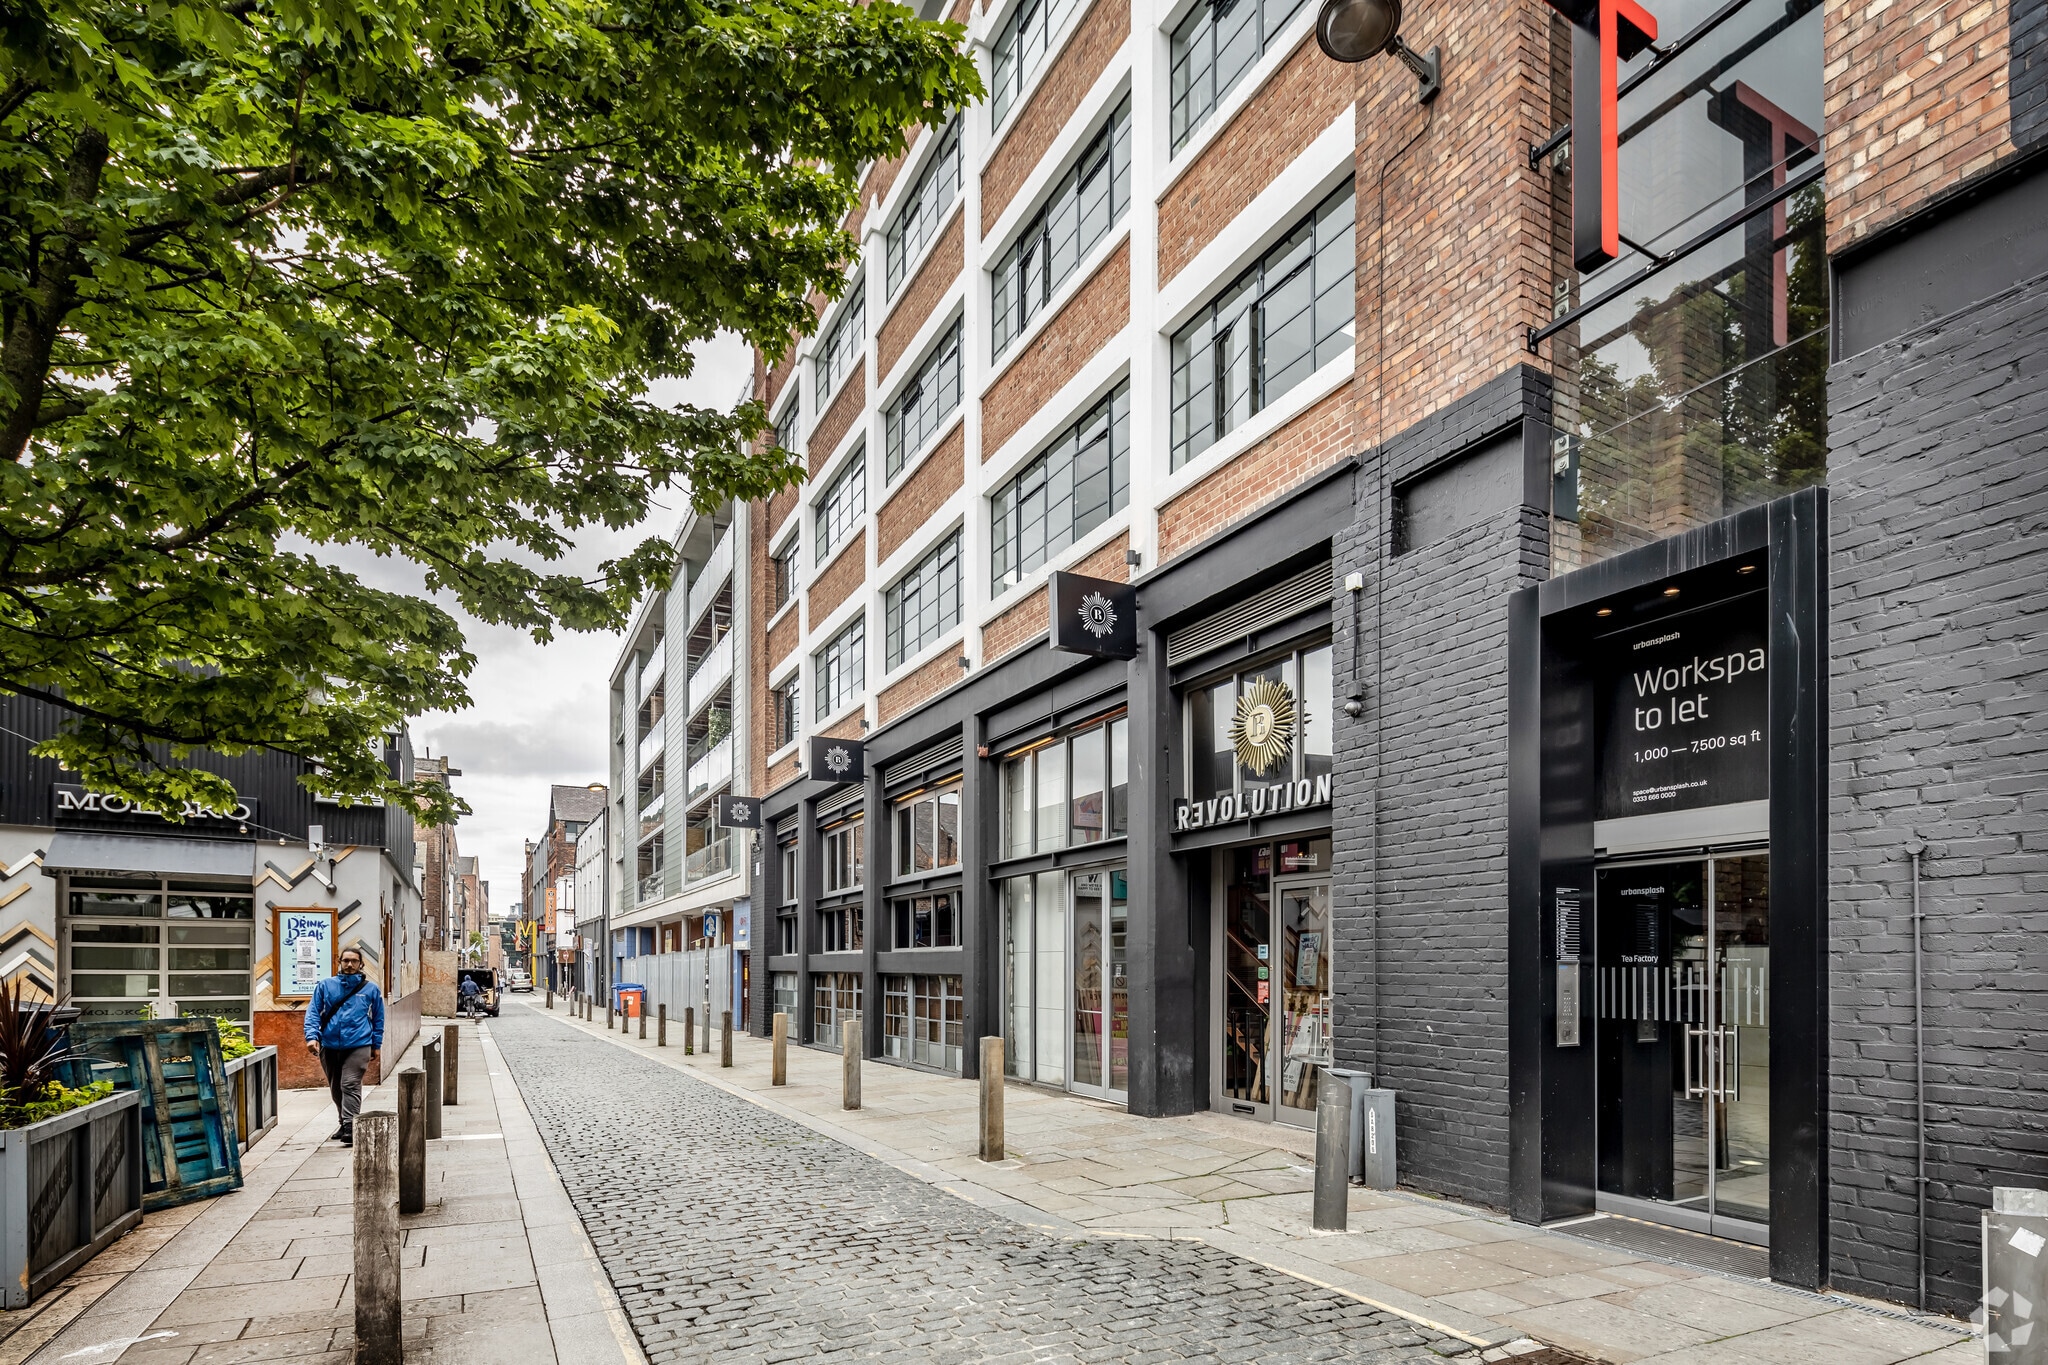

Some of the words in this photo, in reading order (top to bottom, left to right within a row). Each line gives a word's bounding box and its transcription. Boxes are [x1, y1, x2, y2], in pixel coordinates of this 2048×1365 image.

[1633, 631, 1681, 650] urbansplash
[1633, 646, 1765, 697] Workspa
[1634, 701, 1662, 732] to
[1671, 694, 1709, 724] let
[1634, 746, 1668, 763] 1,000
[1690, 736, 1725, 754] 7,500
[1729, 733, 1747, 747] sq
[1750, 730, 1761, 742] ft
[1632, 779, 1708, 796] space@urbansplash.co.uk
[1632, 795, 1647, 803] 0333
[1660, 791, 1676, 799] 0000
[1621, 886, 1665, 896] urbansplash
[288, 916, 328, 930] DRINK
[1633, 954, 1659, 963] Factory
[183, 1007, 242, 1016] MOLOKO
